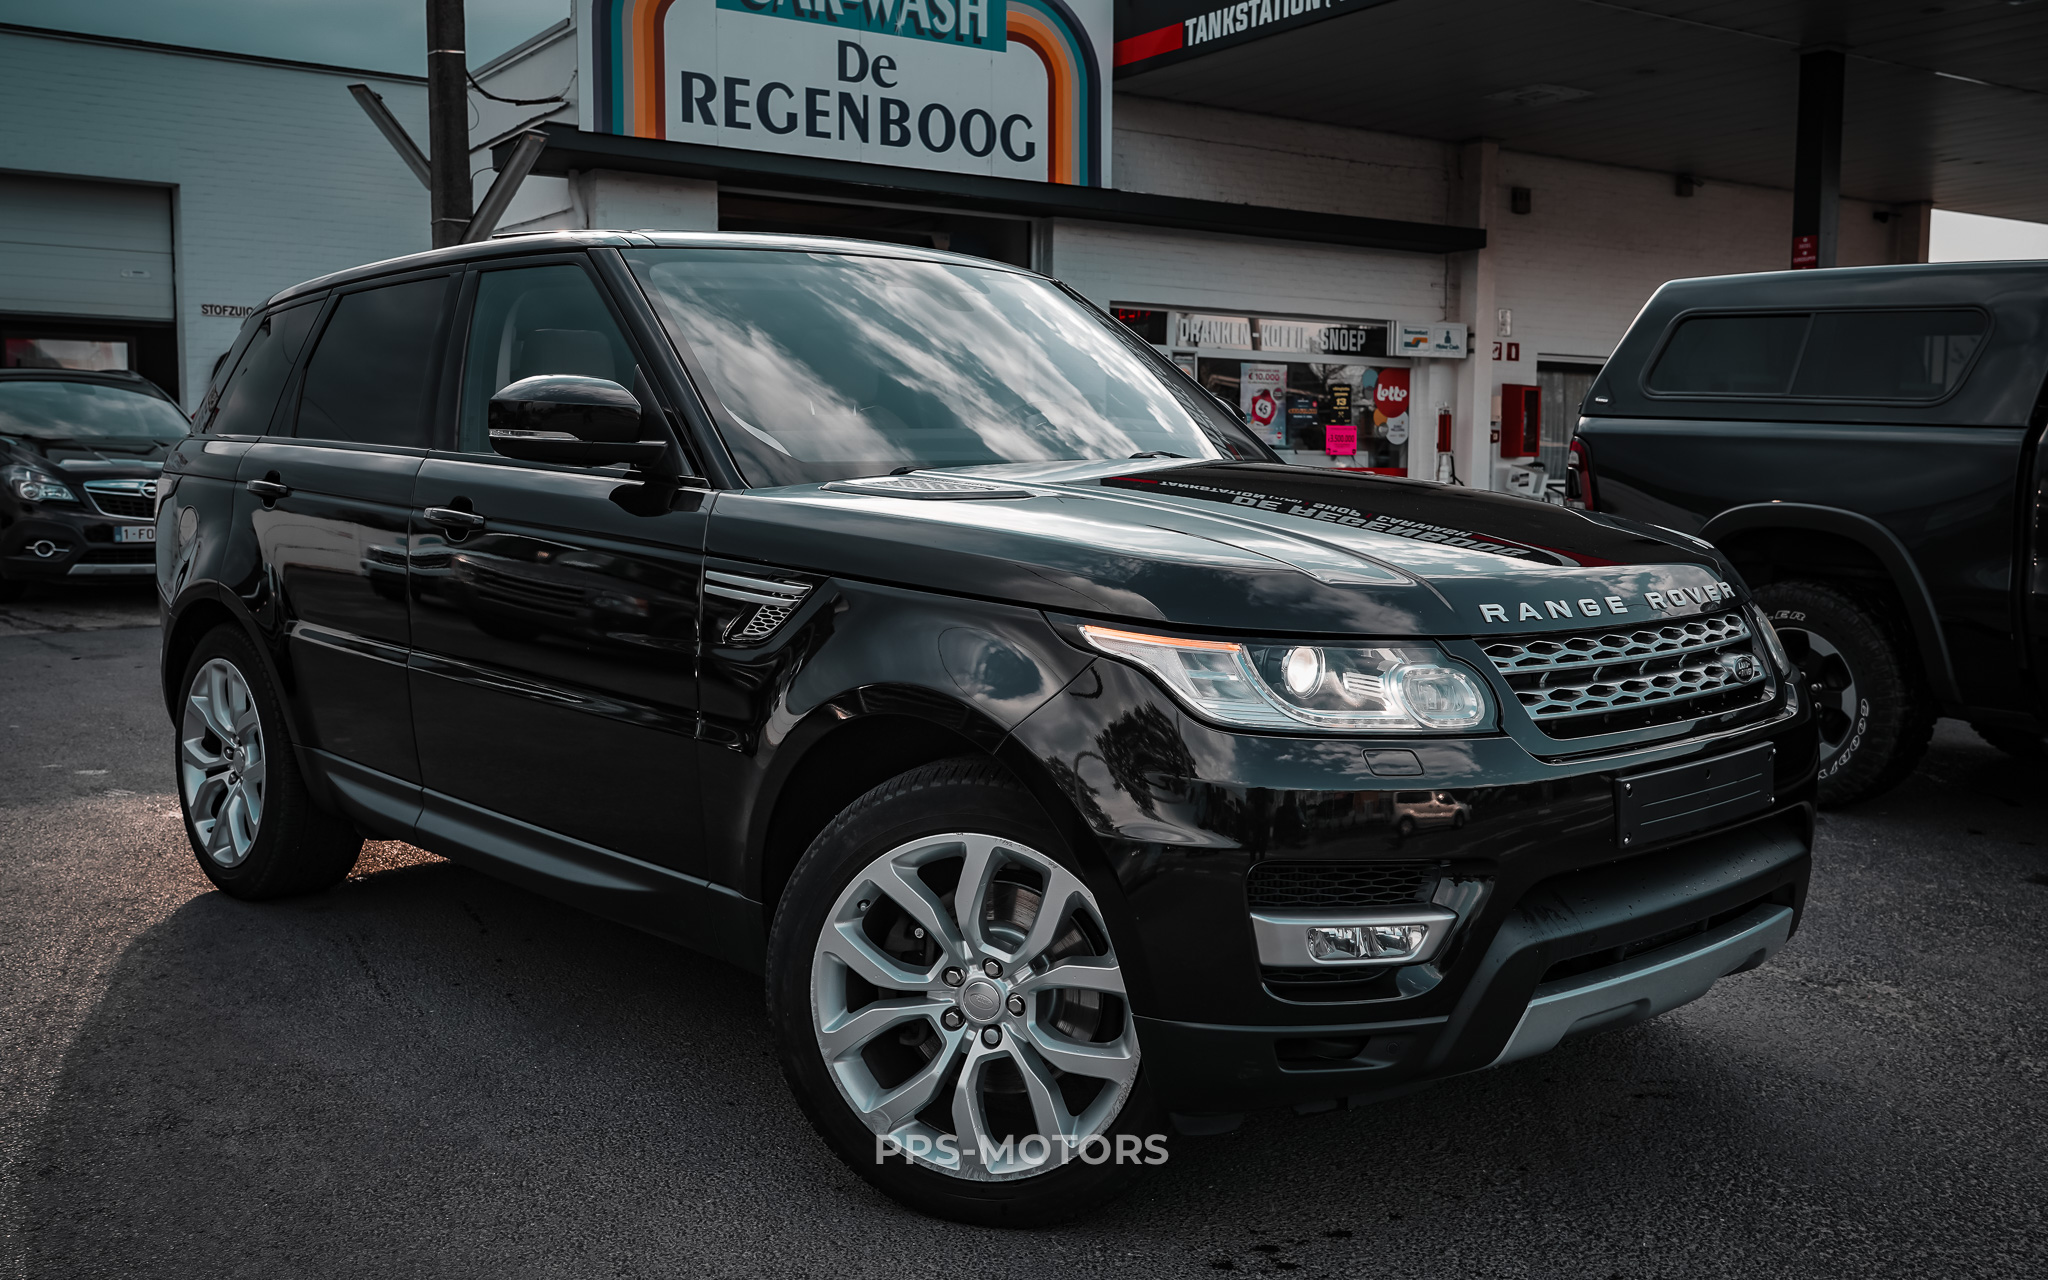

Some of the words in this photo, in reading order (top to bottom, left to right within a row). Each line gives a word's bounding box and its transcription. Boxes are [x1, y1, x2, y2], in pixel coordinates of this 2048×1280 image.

[837, 40, 898, 88] De
[680, 71, 1036, 162] REGENBOOG
[1179, 317, 1250, 345] DRANKEN
[1320, 328, 1366, 352] SNOEP
[1255, 373, 1280, 381] 10.000
[1258, 403, 1269, 415] 45
[1478, 595, 1628, 623] RANGE
[1643, 581, 1736, 611] ROVER
